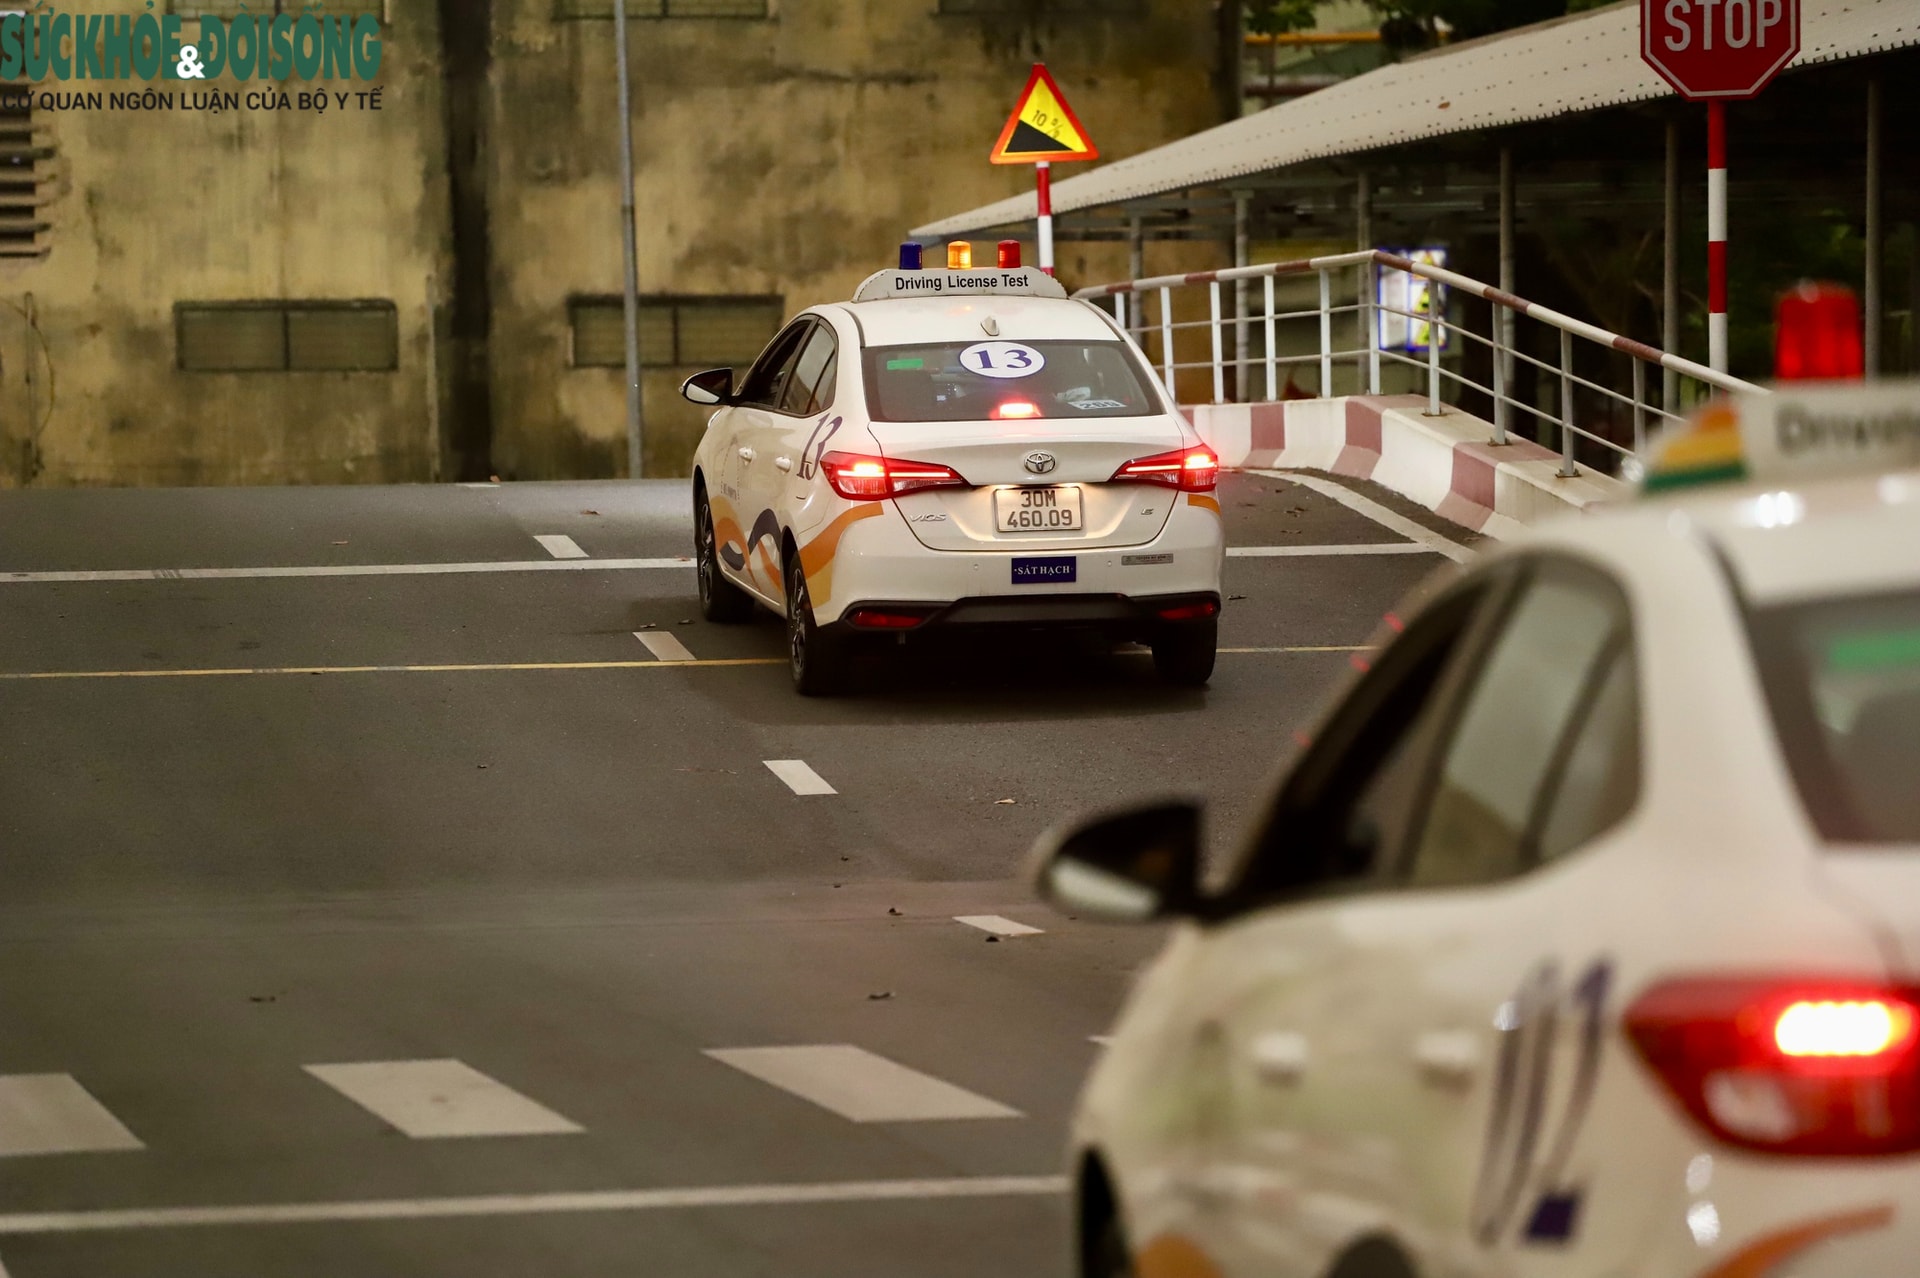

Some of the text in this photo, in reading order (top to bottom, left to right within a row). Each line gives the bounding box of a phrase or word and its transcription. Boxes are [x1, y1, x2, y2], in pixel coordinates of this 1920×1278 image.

[1664, 0, 1782, 51] STOP
[895, 273, 1029, 291] Driving License Test
[972, 349, 1033, 370] 13
[797, 412, 843, 480] 13
[1021, 490, 1056, 507] 30M
[1007, 510, 1072, 528] 460.09
[1040, 565, 1070, 576] HẠCH
